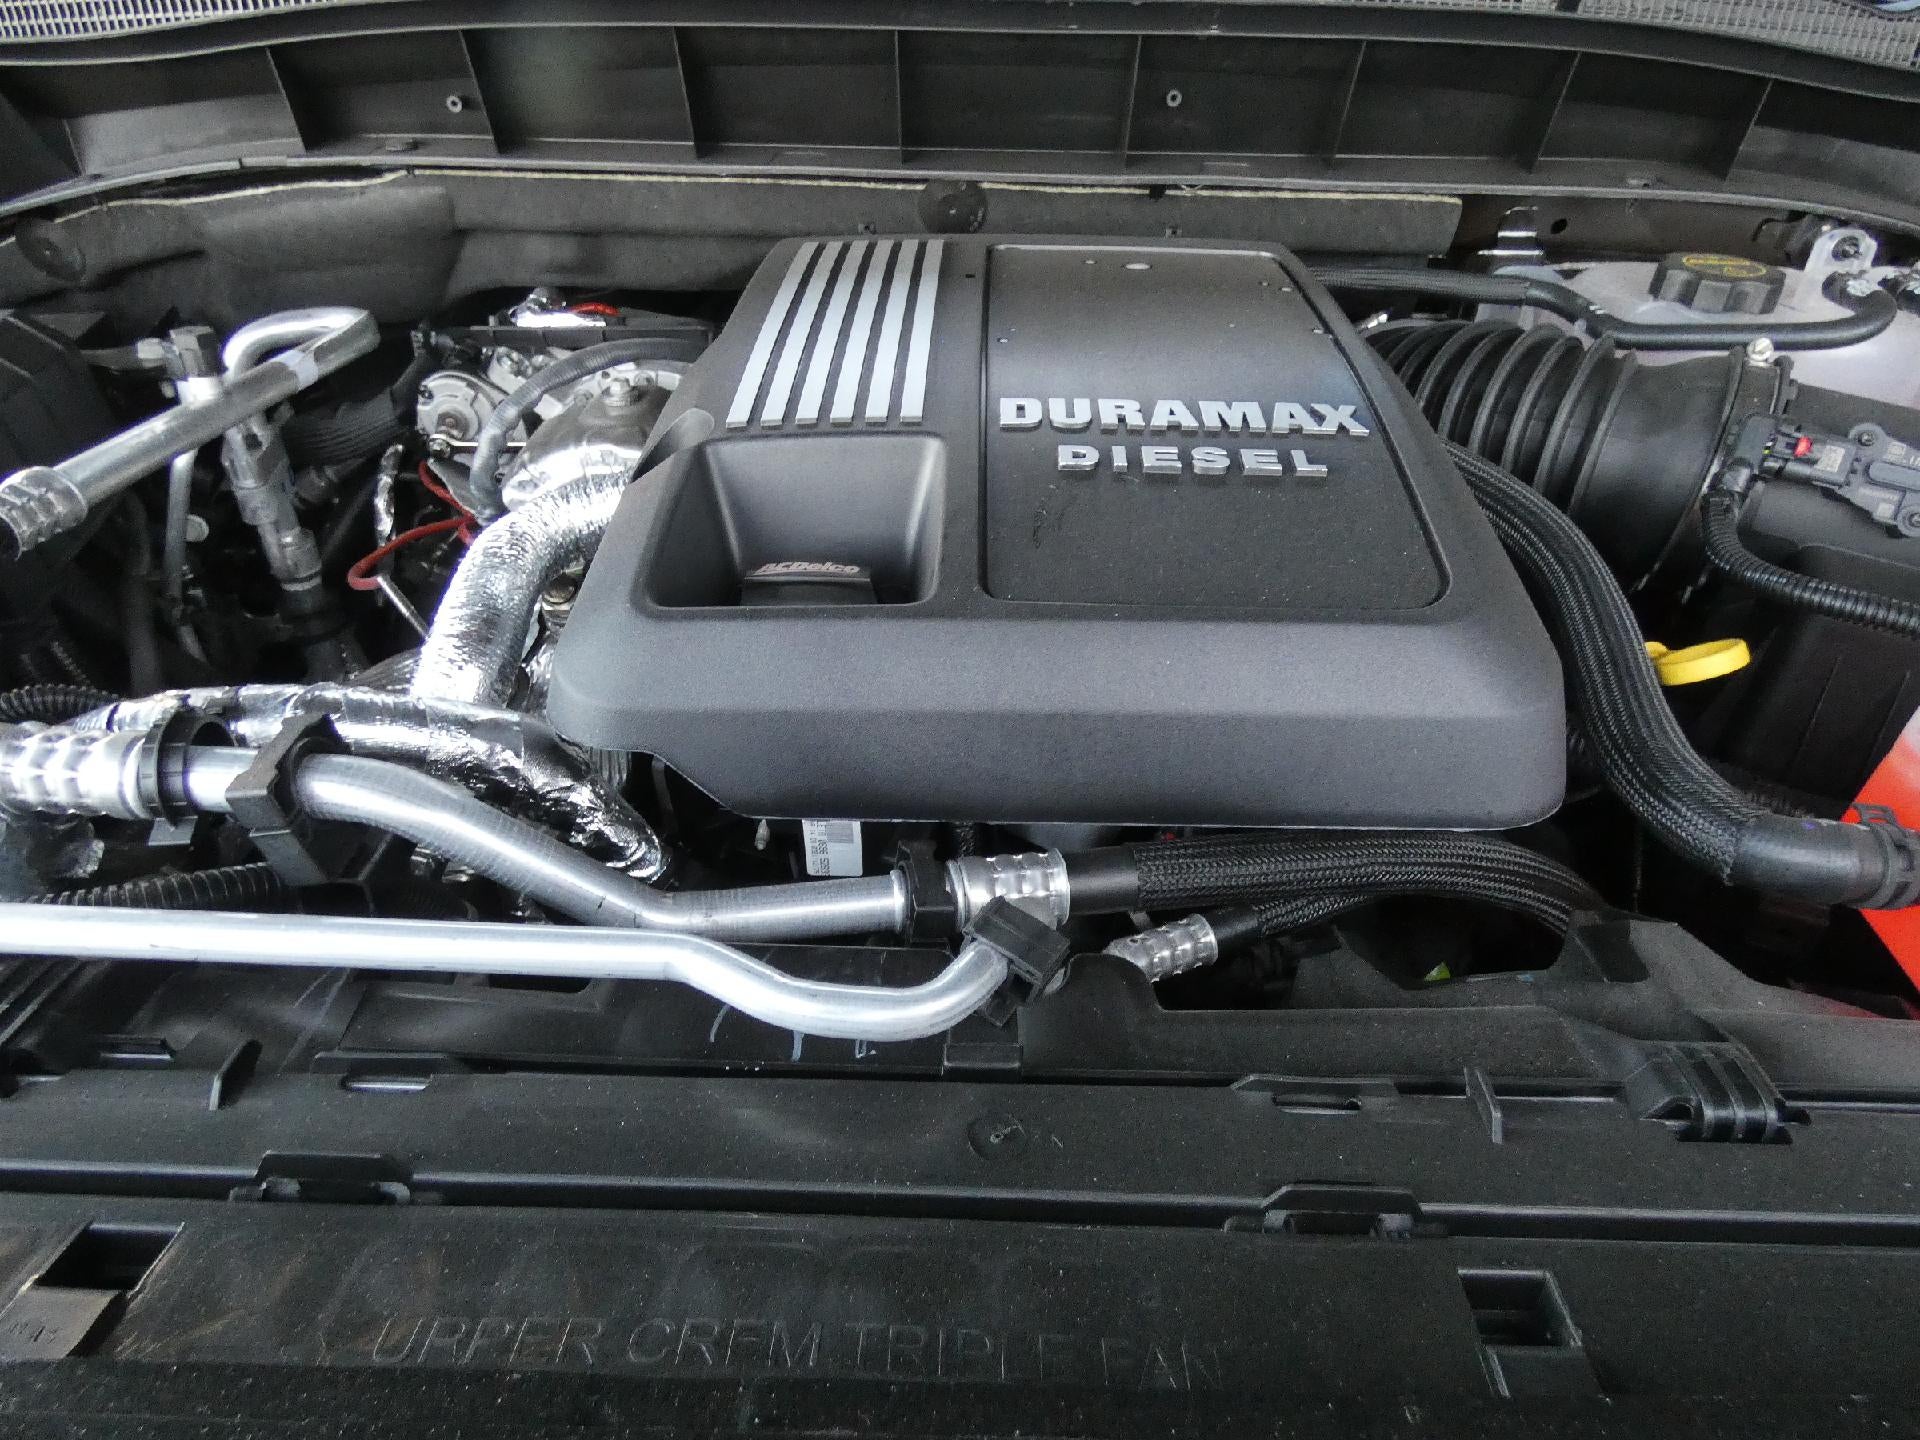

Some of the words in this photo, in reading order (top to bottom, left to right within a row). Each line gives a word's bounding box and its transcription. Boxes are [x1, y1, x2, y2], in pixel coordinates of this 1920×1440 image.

[999, 396, 1370, 436] DURAMAX
[1056, 444, 1329, 477] DIESEL
[753, 561, 860, 576] ACDelco
[373, 1316, 608, 1365] UPPER
[627, 1317, 824, 1369] CRFM
[845, 1321, 1075, 1384] TRIPLE
[1100, 1336, 1226, 1392] FAN
